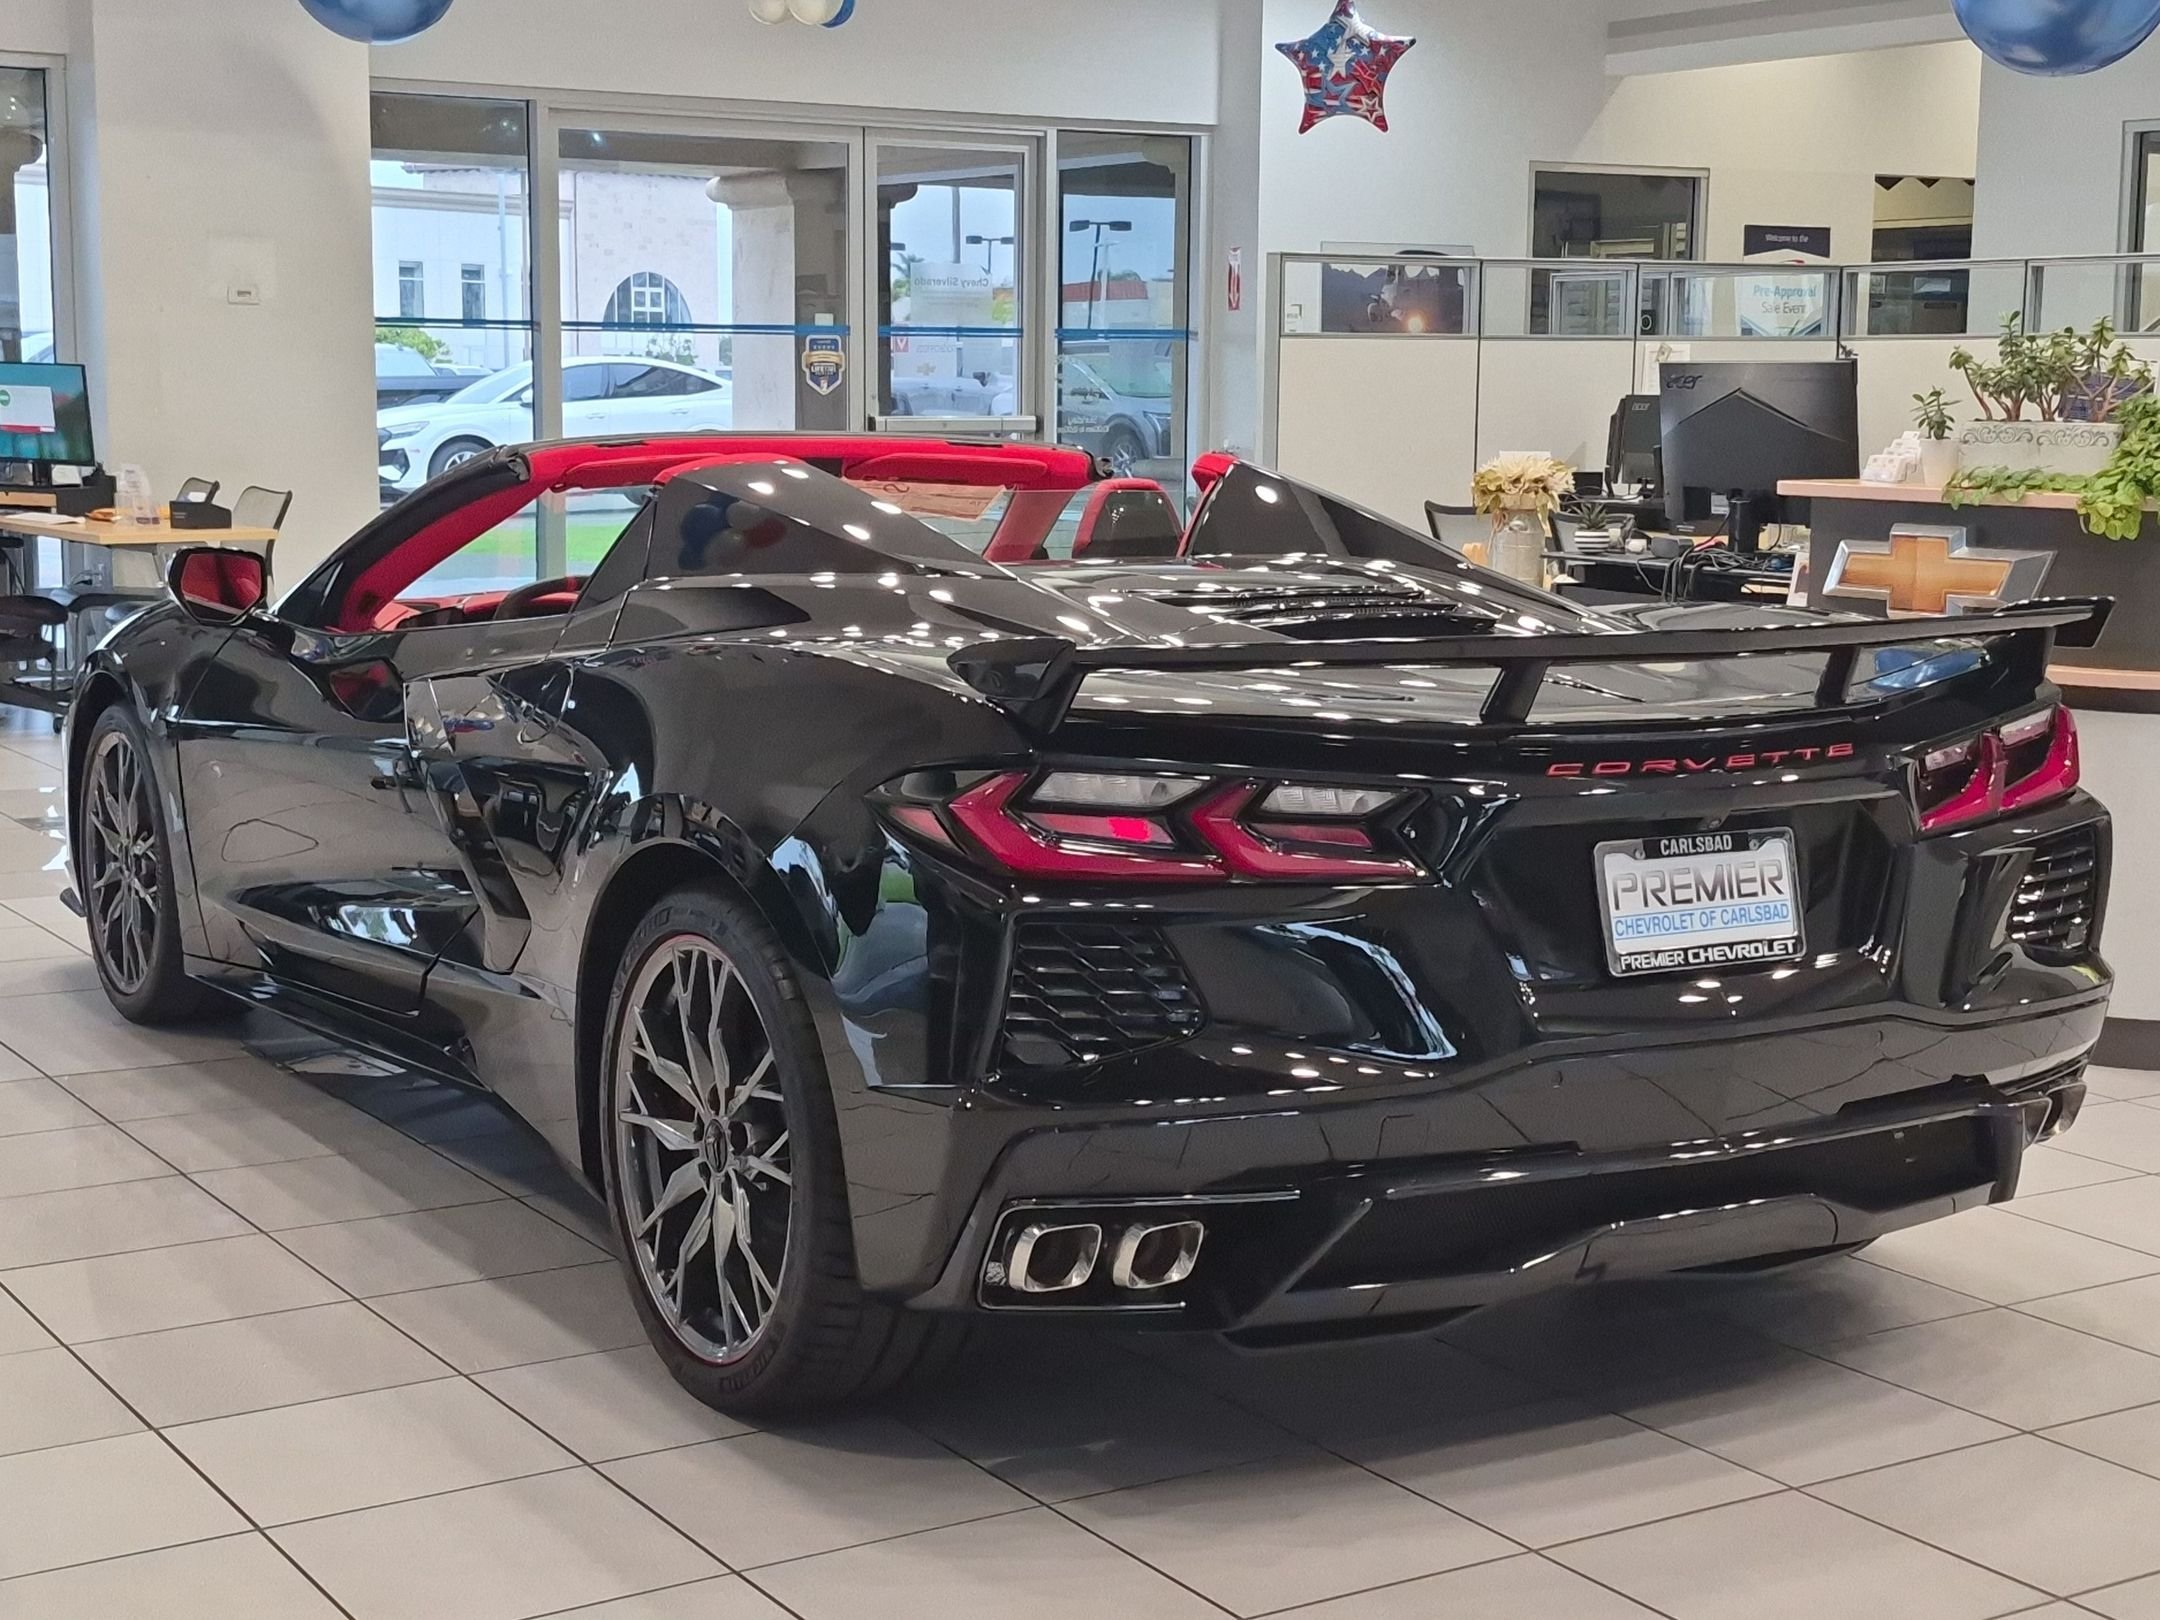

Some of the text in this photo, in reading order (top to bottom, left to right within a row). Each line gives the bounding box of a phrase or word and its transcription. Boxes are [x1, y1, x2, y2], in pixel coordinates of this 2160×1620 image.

[1761, 301, 1781, 314] Sae
[1545, 743, 1854, 777] CORVETTE
[1660, 834, 1732, 856] CARLSBAD
[1612, 858, 1785, 911] PREMIER
[1615, 903, 1790, 937] CHEVROLET OF CARLSBAD
[1620, 939, 1796, 971] PREMIER CHEVROLET
